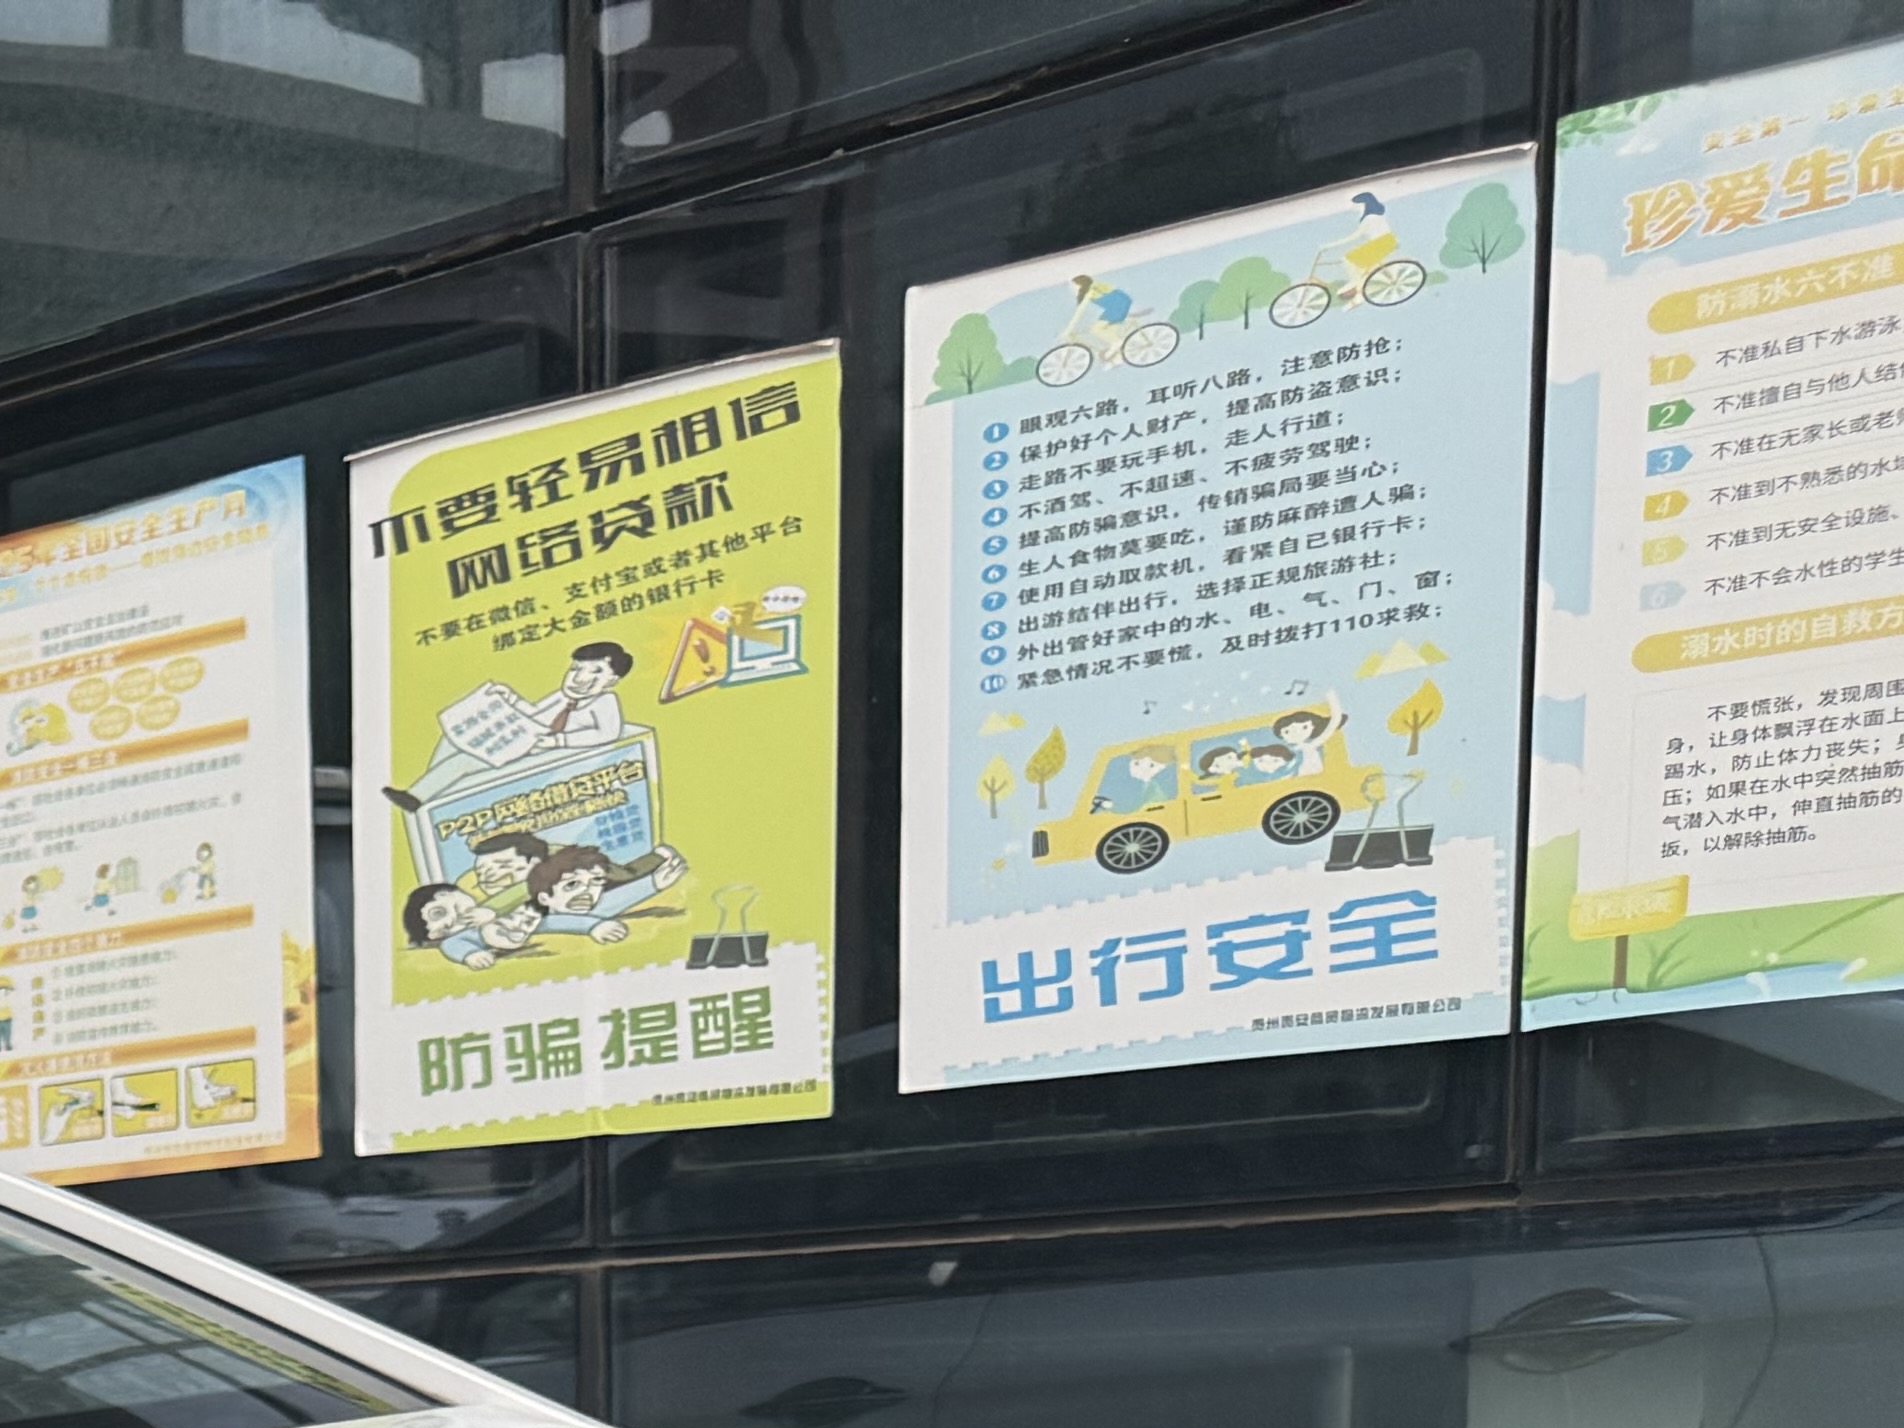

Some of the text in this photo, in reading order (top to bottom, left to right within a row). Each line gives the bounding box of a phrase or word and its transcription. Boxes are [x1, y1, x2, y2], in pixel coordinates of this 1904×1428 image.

[1696, 252, 1895, 320] 防溺水六不准
[1659, 404, 1676, 428] 2
[368, 381, 801, 558] 不要轻易相信
[1657, 449, 1673, 472] 3
[446, 471, 733, 599] 网络贷款
[1704, 546, 1904, 596] 不准不会水性的学生
[415, 515, 803, 647] 不要在微信、支付宝或者其他平台
[492, 568, 726, 653] 绑定大金额的银行卡
[1680, 602, 1904, 661] 溺水时的自救方
[981, 889, 1438, 1024] 出行安全
[418, 986, 774, 1097] 防骗提醒
